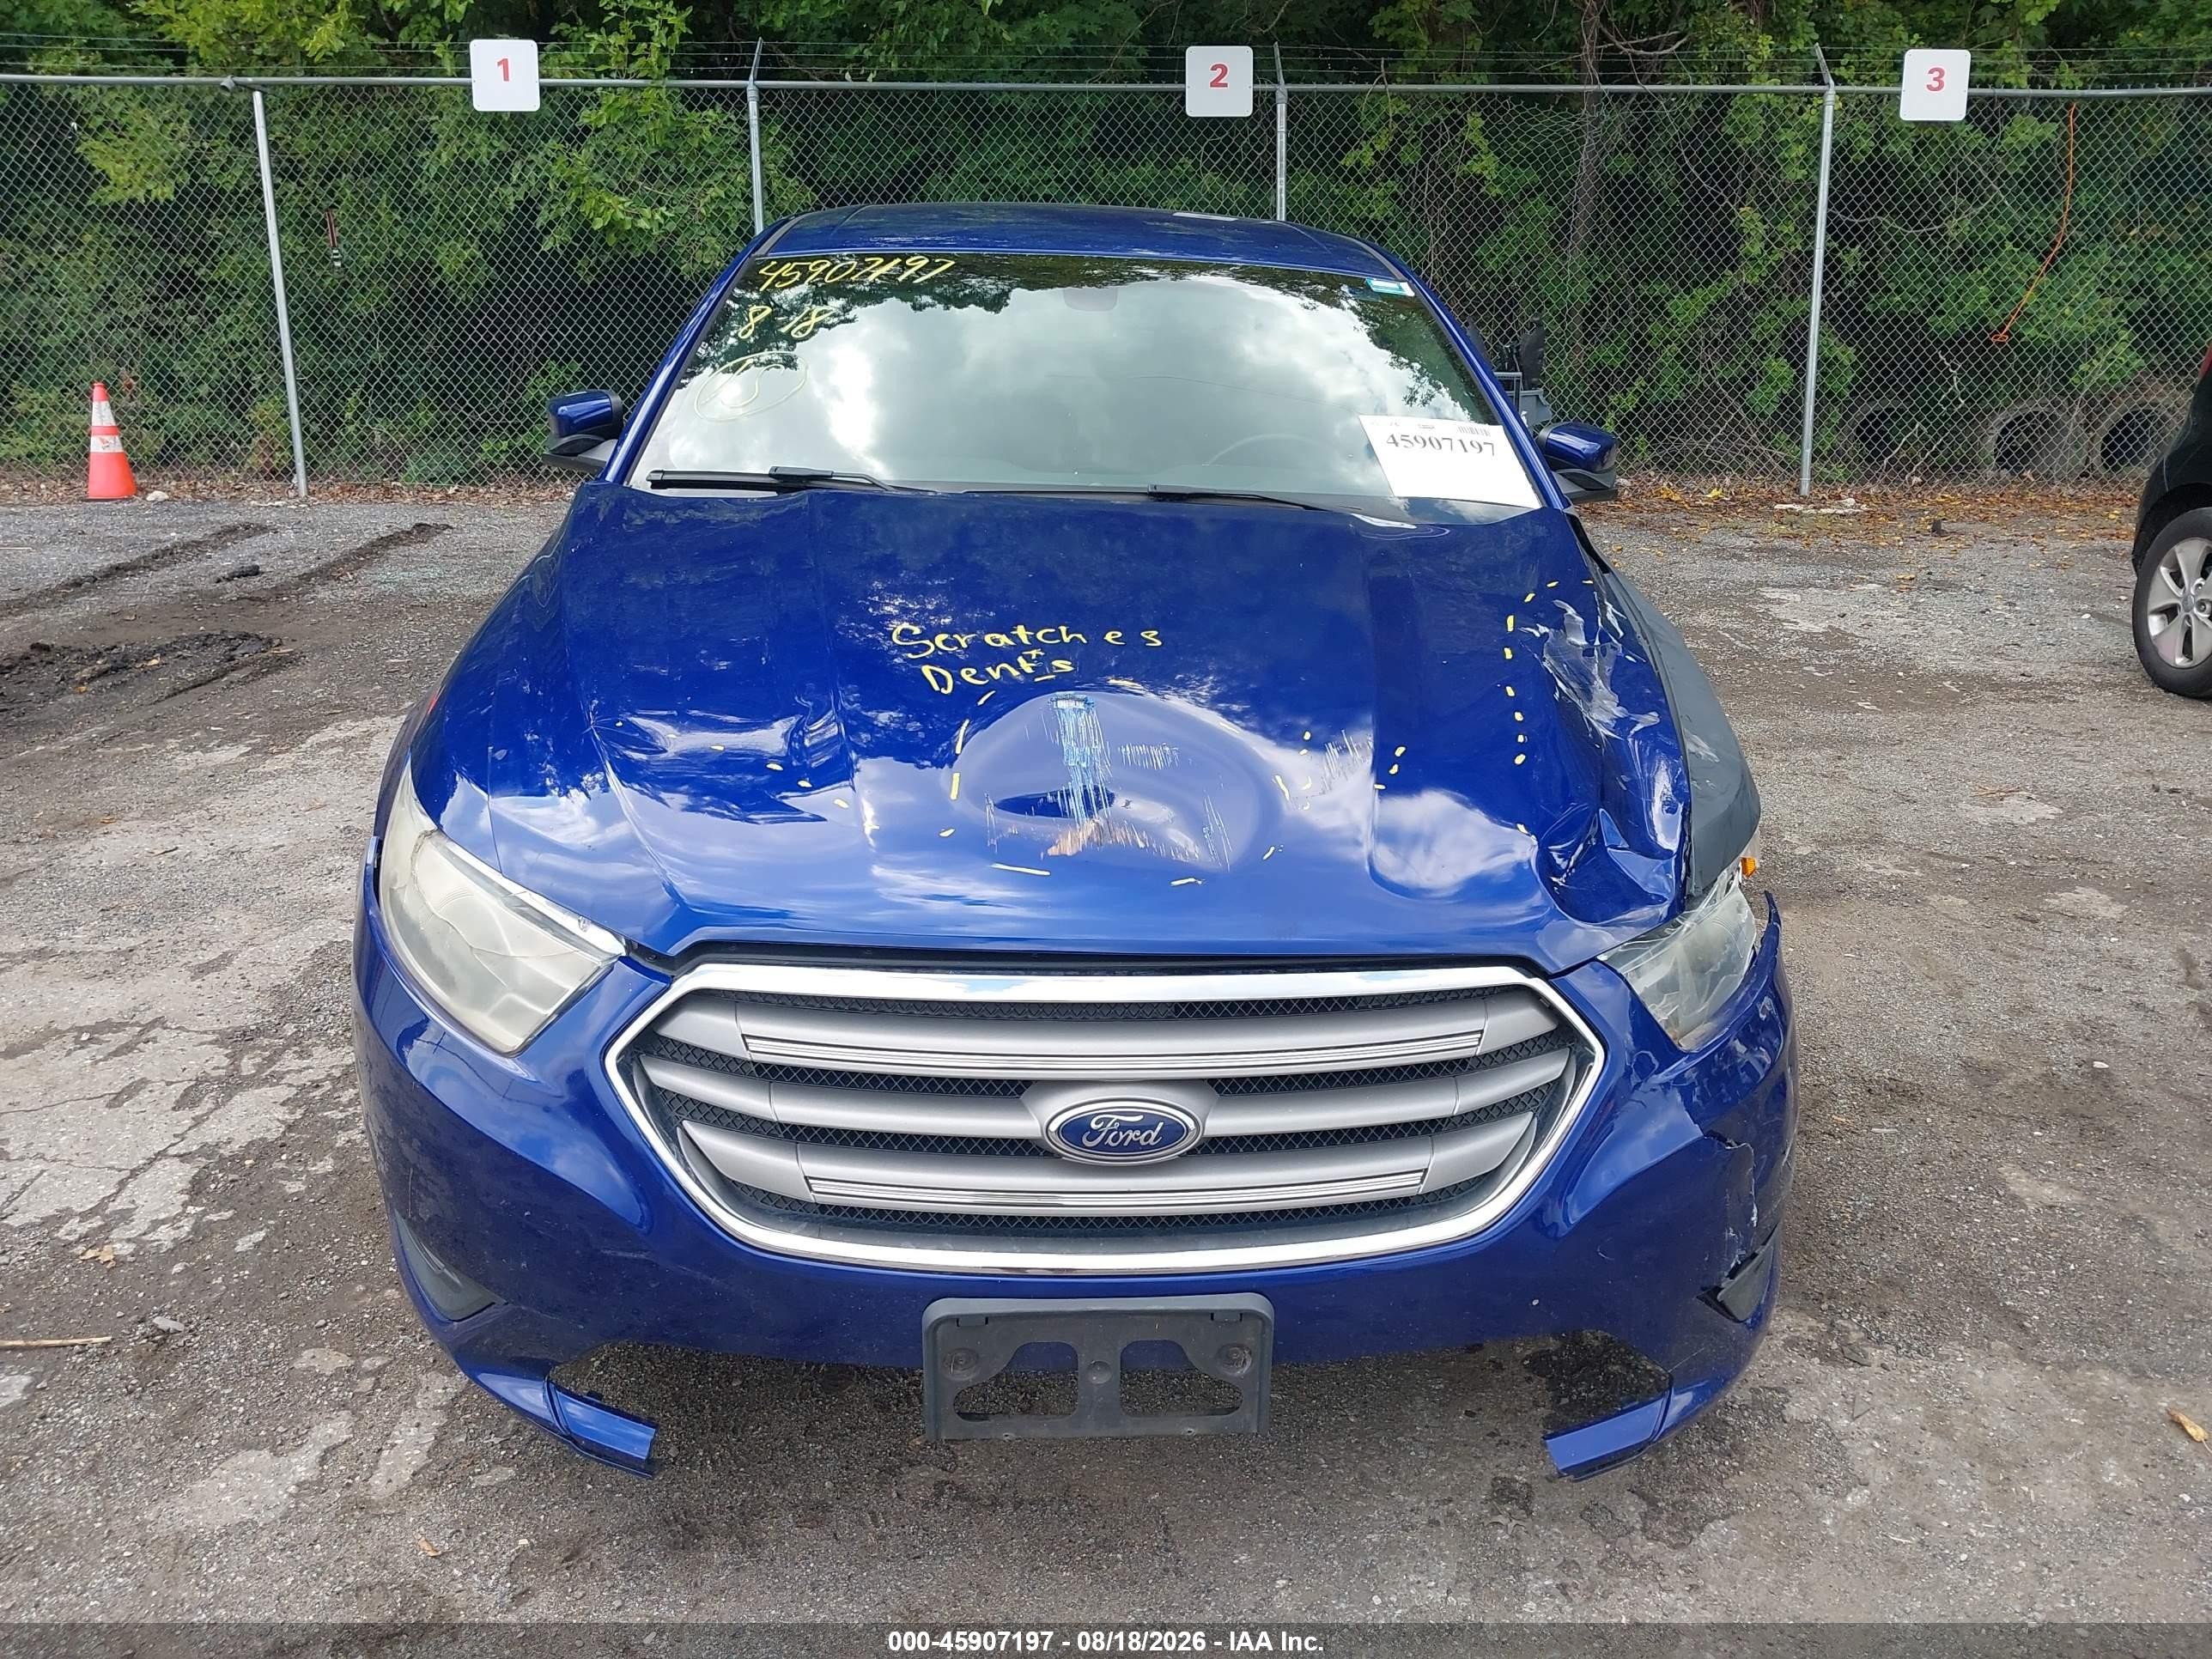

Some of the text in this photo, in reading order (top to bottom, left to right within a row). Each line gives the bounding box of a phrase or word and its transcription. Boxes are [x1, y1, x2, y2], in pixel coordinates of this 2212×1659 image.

[497, 58, 509, 82] 1
[1209, 64, 1228, 88] 2
[1926, 67, 1945, 92] 3
[1386, 433, 1495, 457] 45907197
[1082, 1114, 1163, 1147] Ford
